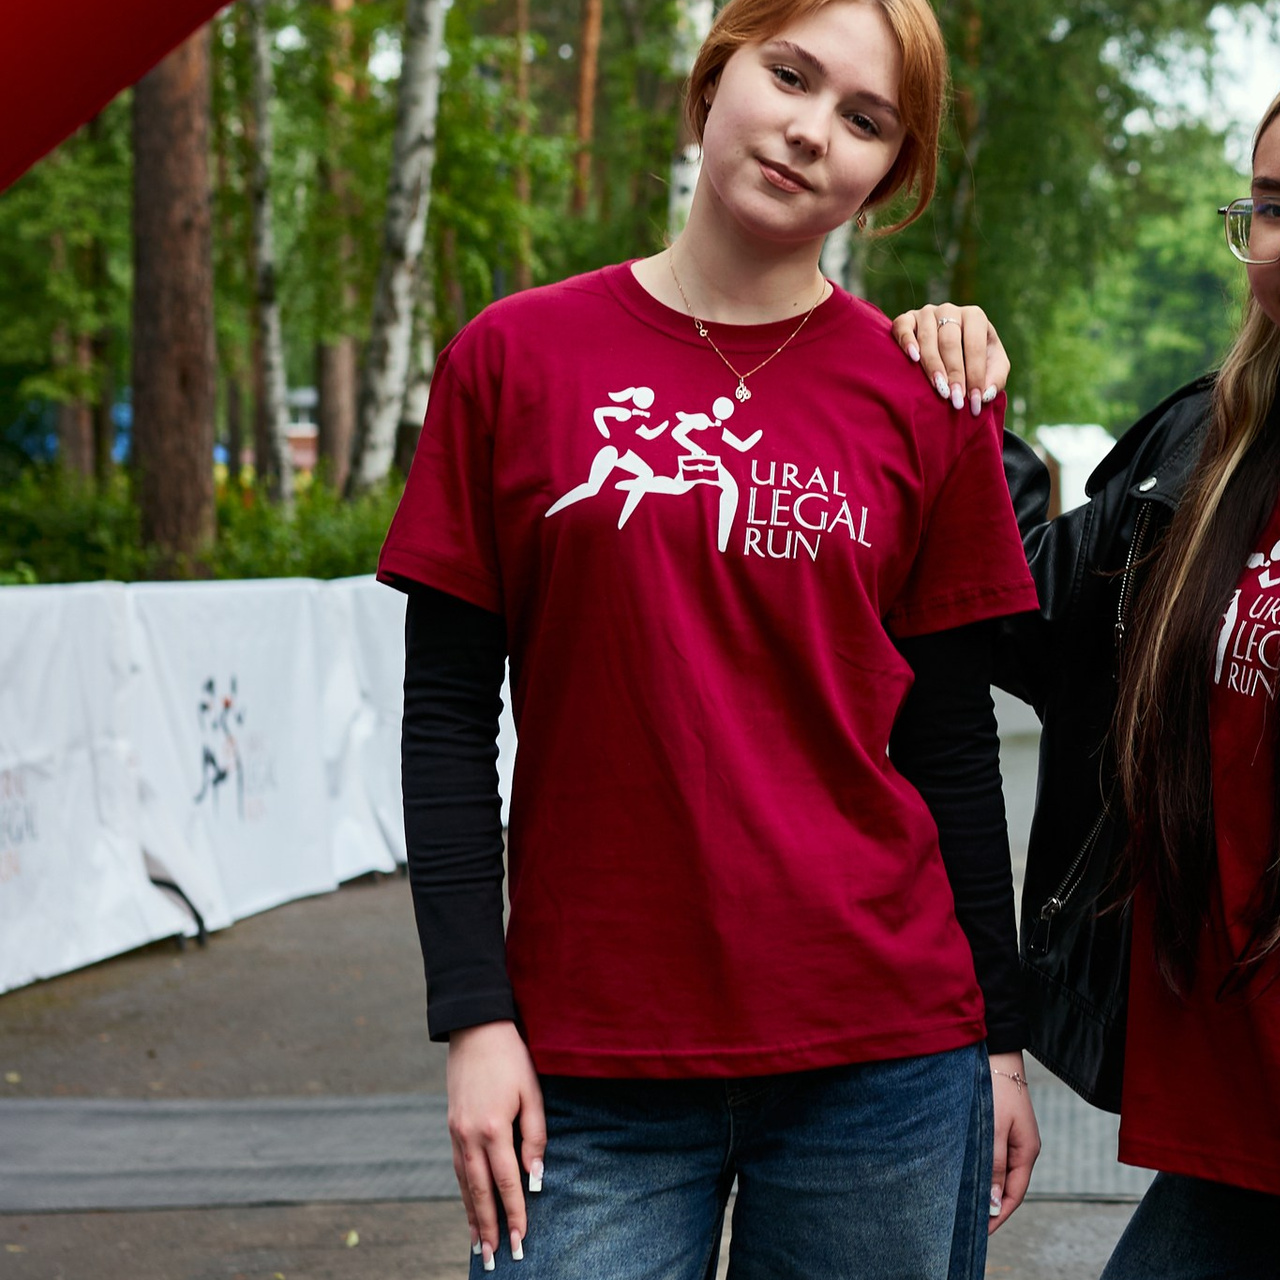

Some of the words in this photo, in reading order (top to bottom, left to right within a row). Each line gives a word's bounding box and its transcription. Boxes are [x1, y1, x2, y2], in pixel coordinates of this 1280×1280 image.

[751, 459, 847, 498] URAL
[746, 486, 872, 548] LEGAL
[743, 527, 821, 562] RUN
[1227, 661, 1277, 701] RUN
